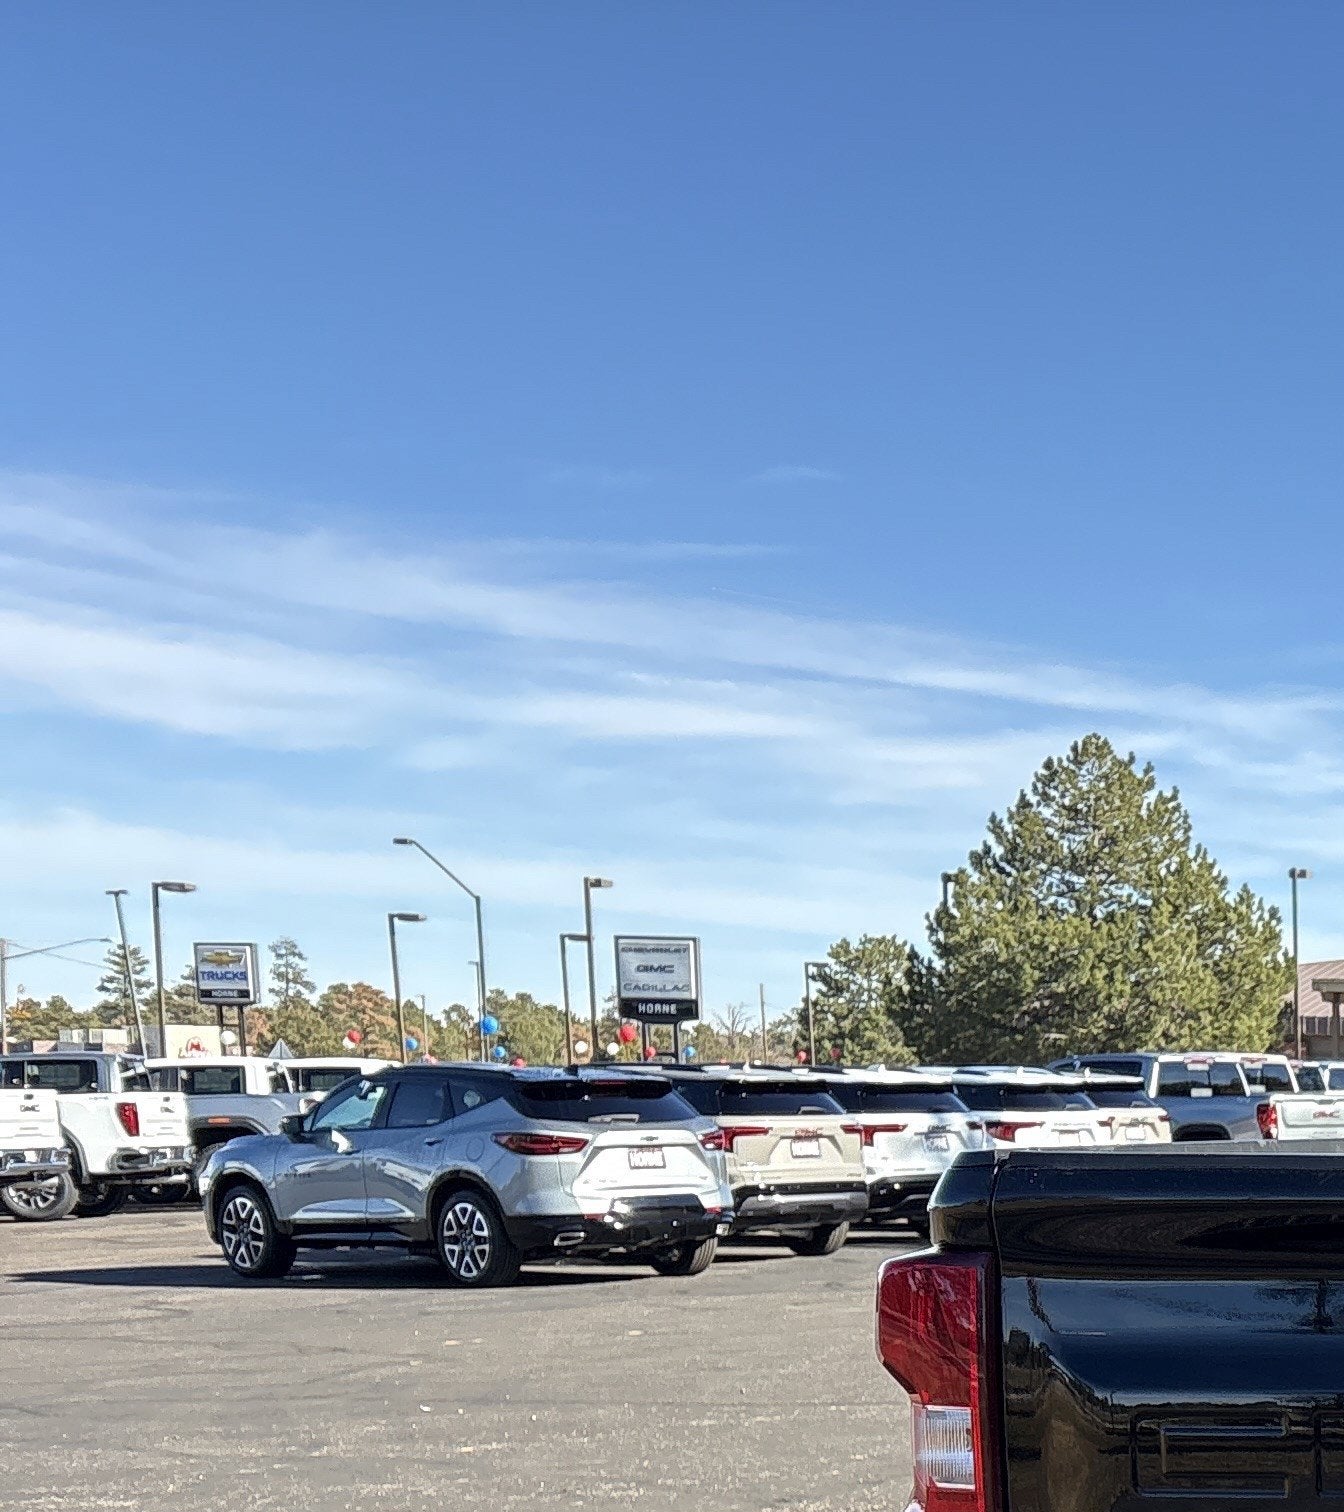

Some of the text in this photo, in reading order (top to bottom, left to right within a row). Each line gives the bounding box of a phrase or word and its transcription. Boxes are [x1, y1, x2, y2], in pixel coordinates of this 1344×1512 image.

[636, 964, 675, 974] GMC
[200, 970, 247, 981] TRUCKS
[623, 982, 690, 993] CADILLAC
[638, 1002, 677, 1015] HORNE
